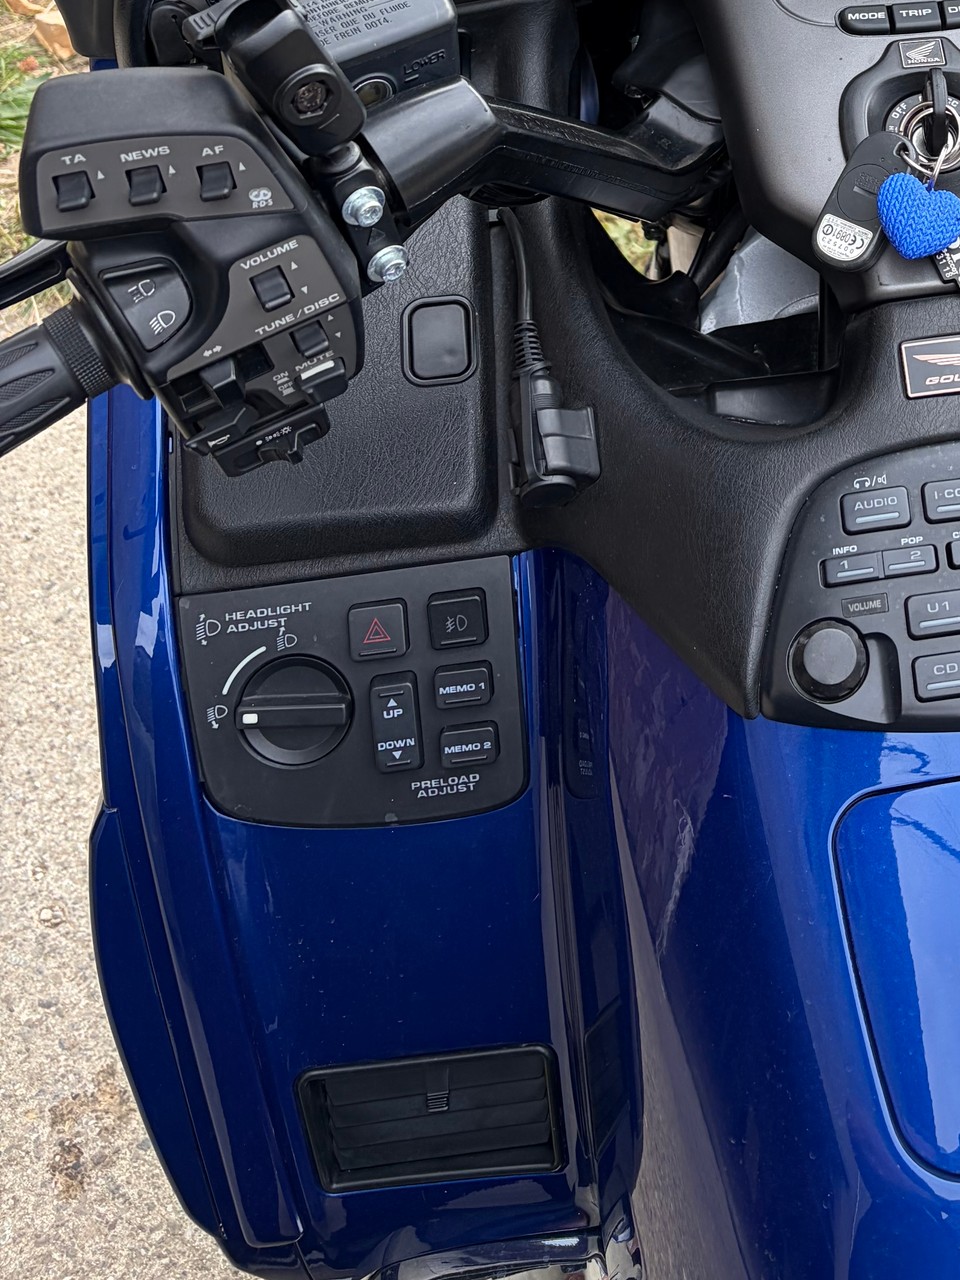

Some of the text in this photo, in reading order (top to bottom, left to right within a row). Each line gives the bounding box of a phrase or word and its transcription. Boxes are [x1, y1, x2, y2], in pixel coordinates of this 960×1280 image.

[318, 7, 368, 27] WARNING
[848, 12, 885, 20] MODE
[900, 9, 932, 17] TRIP
[403, 49, 446, 73] LOWER
[907, 56, 941, 64] HONDA
[891, 103, 907, 119] OFF
[120, 145, 170, 163] NEWS
[202, 145, 224, 157] AF
[61, 153, 86, 164] TA
[240, 240, 299, 270] VOLUME
[295, 351, 334, 371] MUTE
[854, 497, 898, 511] AUDIO
[901, 536, 923, 545] POP
[833, 545, 857, 555] INFO
[910, 551, 921, 560] 2
[840, 560, 848, 569] 1
[225, 602, 312, 621] HEADLIGHT
[848, 600, 881, 612] VOLUME
[226, 618, 287, 633] ADJUST
[934, 663, 958, 674] CD
[439, 682, 485, 694] MEMO 1
[383, 708, 403, 719] UP
[377, 738, 415, 751] DOWN
[444, 742, 491, 754] MEMO 2
[411, 774, 480, 790] PRELOAD
[417, 783, 476, 798] ADJUST
